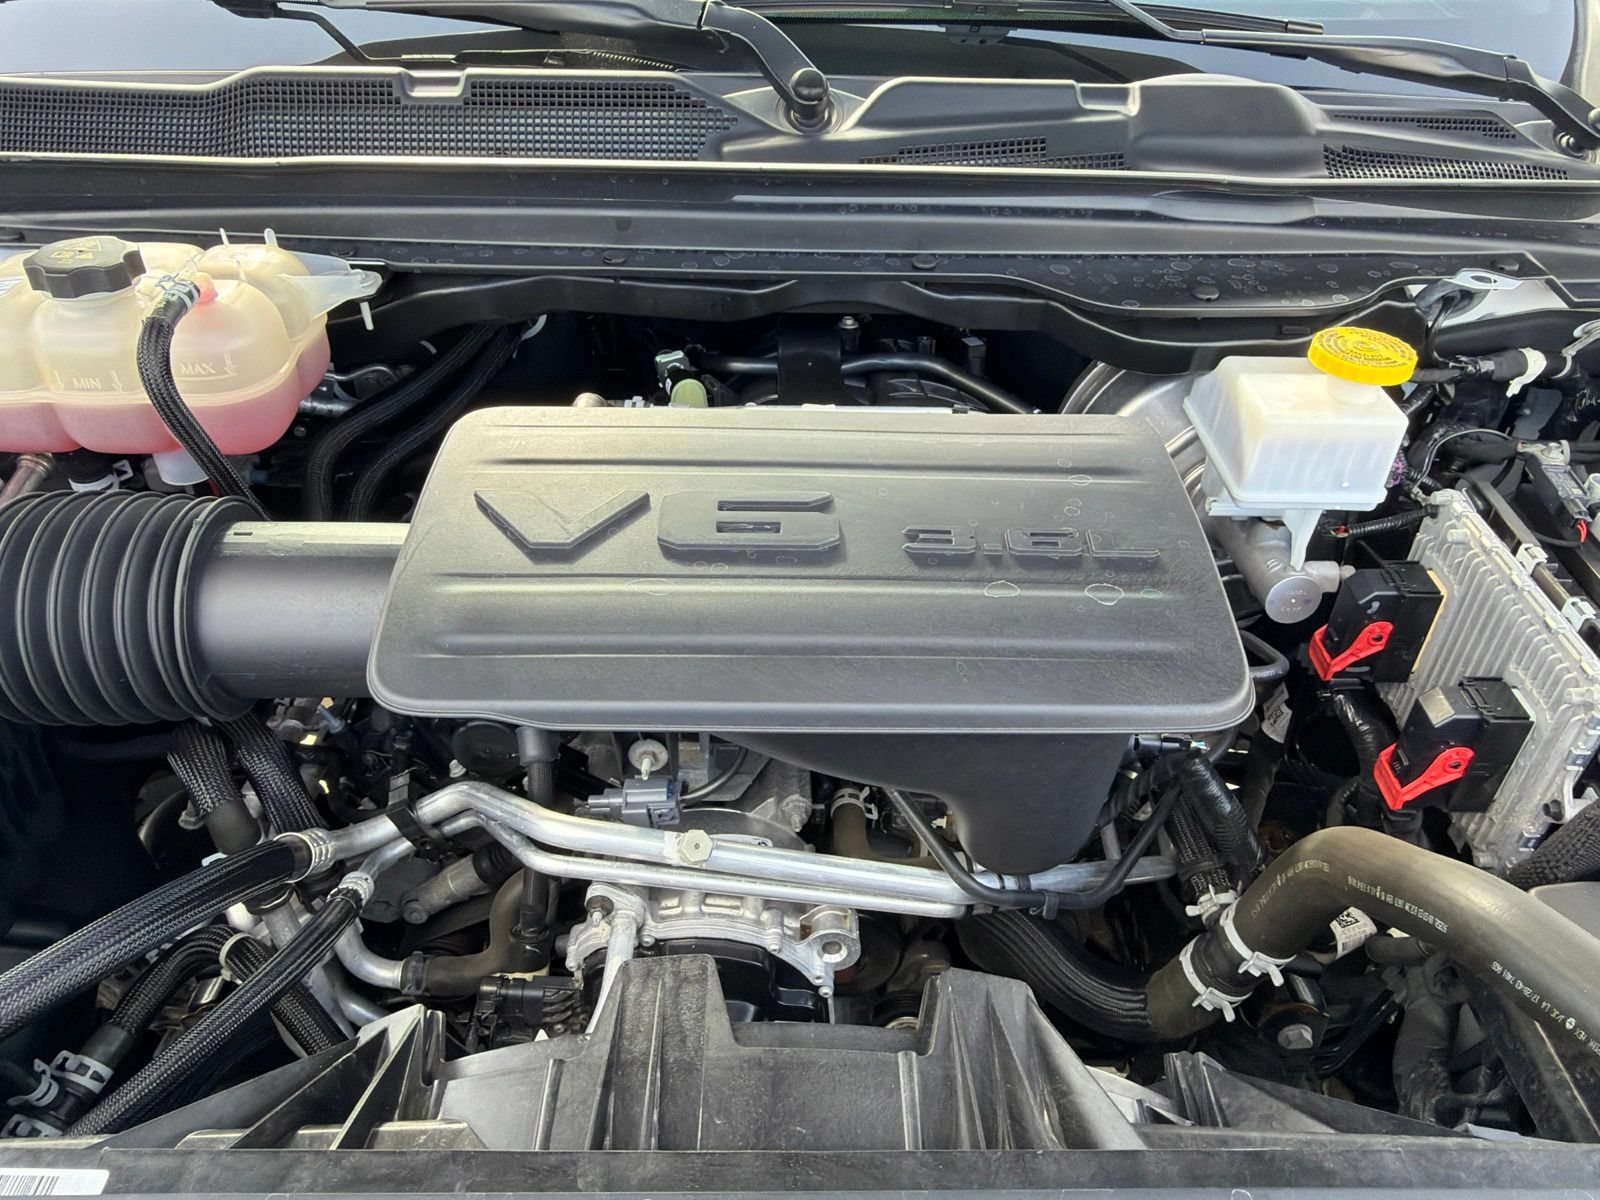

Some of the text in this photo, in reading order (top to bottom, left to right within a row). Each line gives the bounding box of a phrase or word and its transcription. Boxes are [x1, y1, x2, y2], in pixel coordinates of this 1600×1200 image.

[180, 362, 216, 375] MAX
[73, 377, 102, 390] MIN
[474, 490, 841, 553] V6
